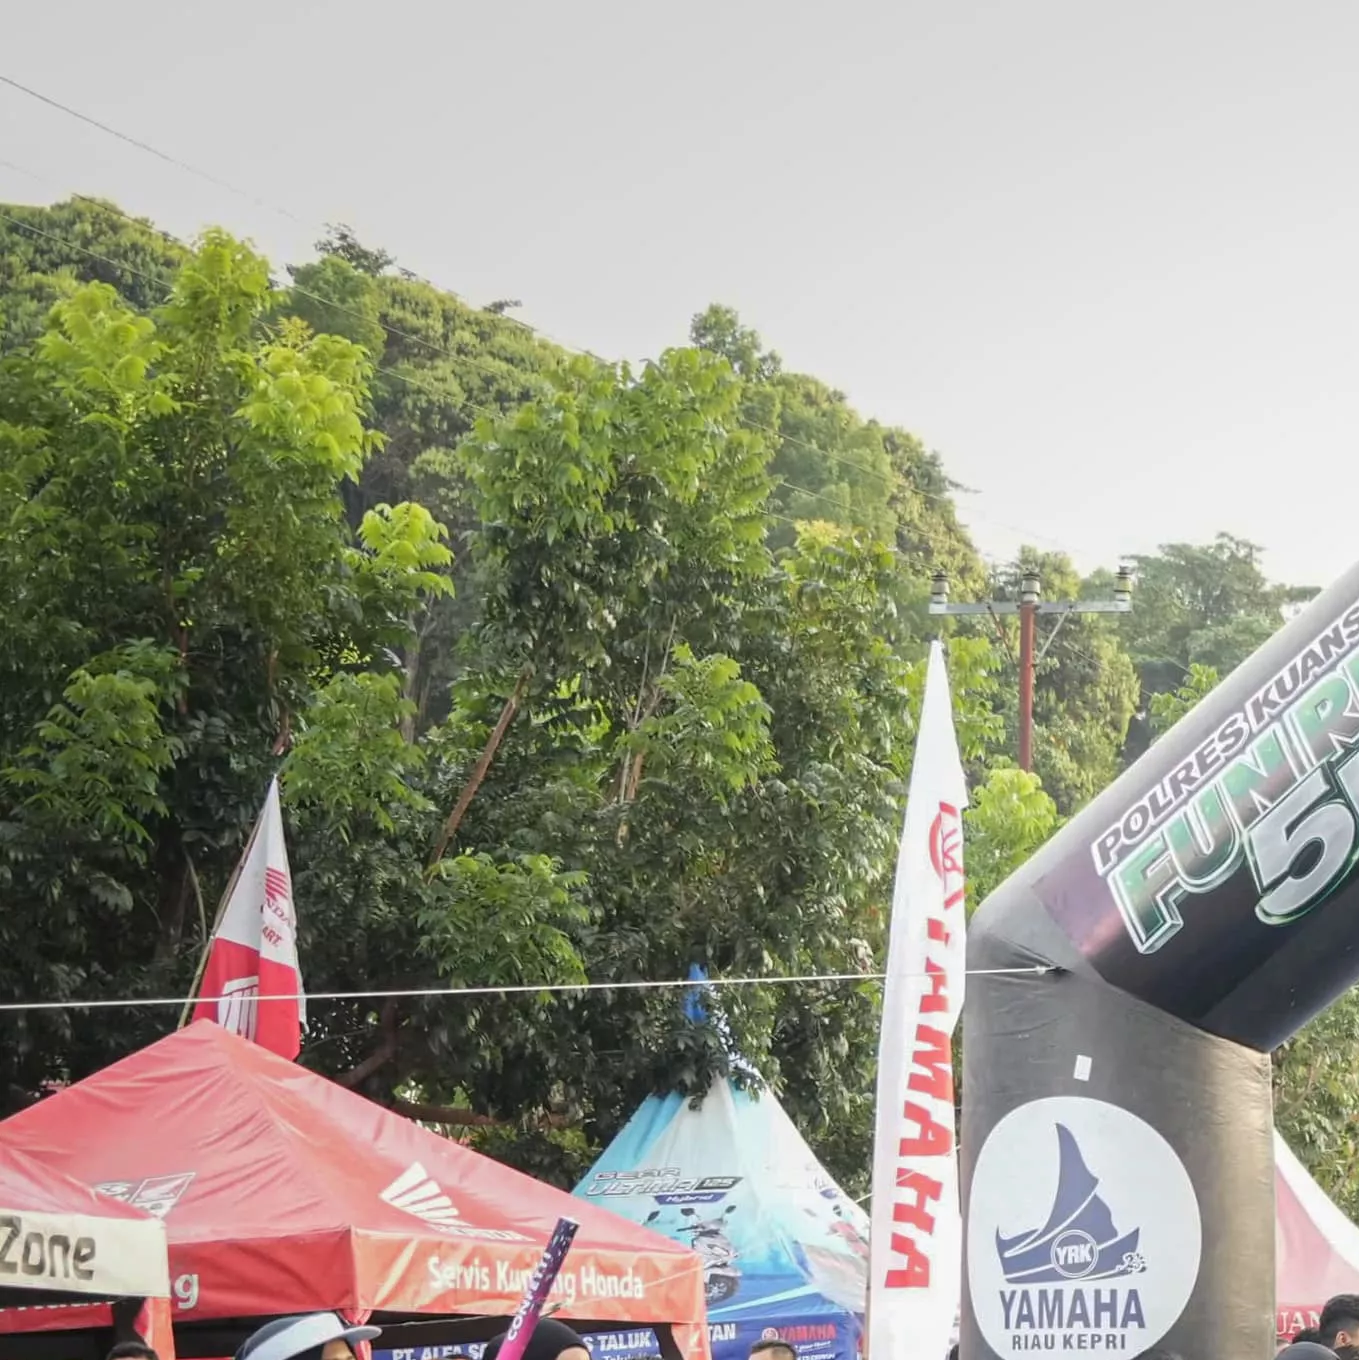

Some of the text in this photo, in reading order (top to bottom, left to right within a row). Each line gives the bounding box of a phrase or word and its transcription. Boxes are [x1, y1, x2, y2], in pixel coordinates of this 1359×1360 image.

[1091, 710, 1251, 878] POLRES
[1108, 715, 1303, 954] FUN
[1056, 1243, 1092, 1265] YRK
[428, 1256, 491, 1291] Servis
[581, 1264, 645, 1299] Honda
[999, 1288, 1146, 1330] YAMAHA
[1012, 1333, 1126, 1351] RIAU KEPRI
